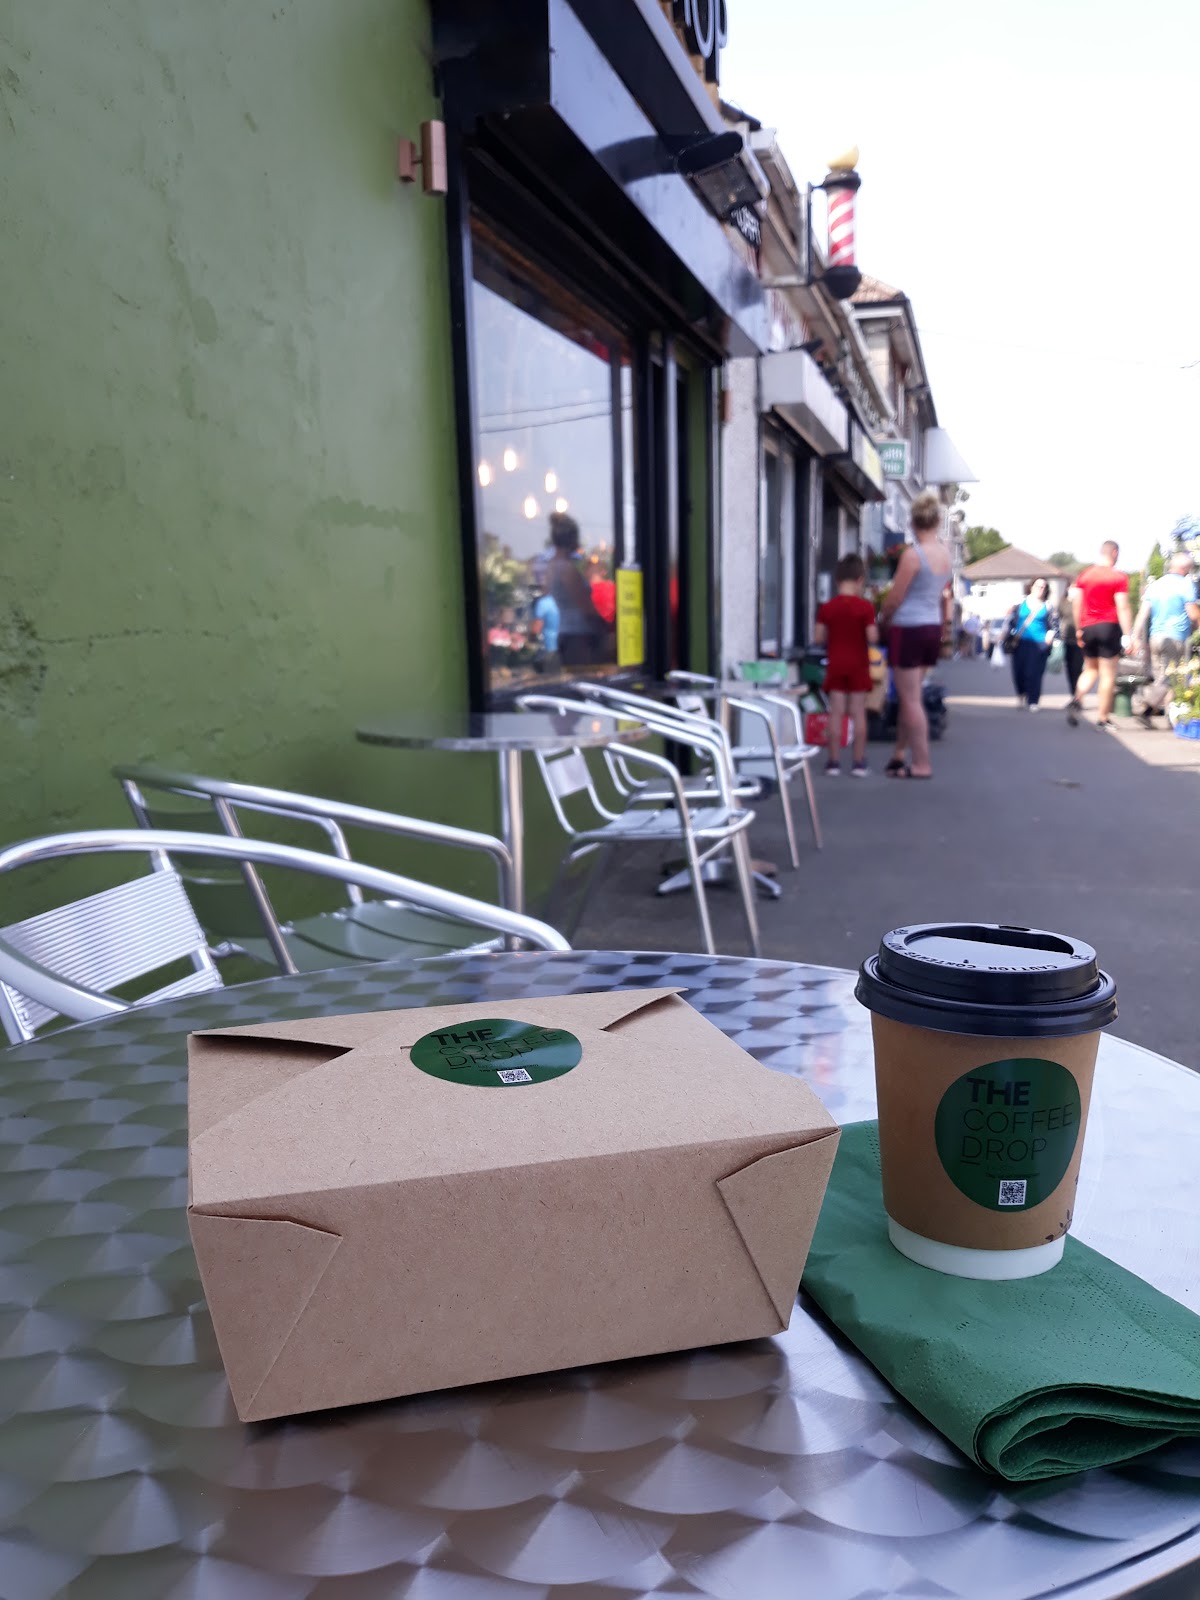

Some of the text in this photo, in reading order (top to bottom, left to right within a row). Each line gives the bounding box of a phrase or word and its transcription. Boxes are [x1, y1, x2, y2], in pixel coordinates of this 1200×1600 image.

[904, 951, 977, 969] CONTENTS
[987, 964, 1059, 972] CAUTION
[430, 1028, 496, 1046] THE
[439, 1031, 562, 1055] COFFEE
[445, 1046, 534, 1067] DROP
[966, 1077, 1031, 1106] THE
[963, 1102, 1075, 1134] COFFEE
[961, 1135, 1047, 1162] DROP
